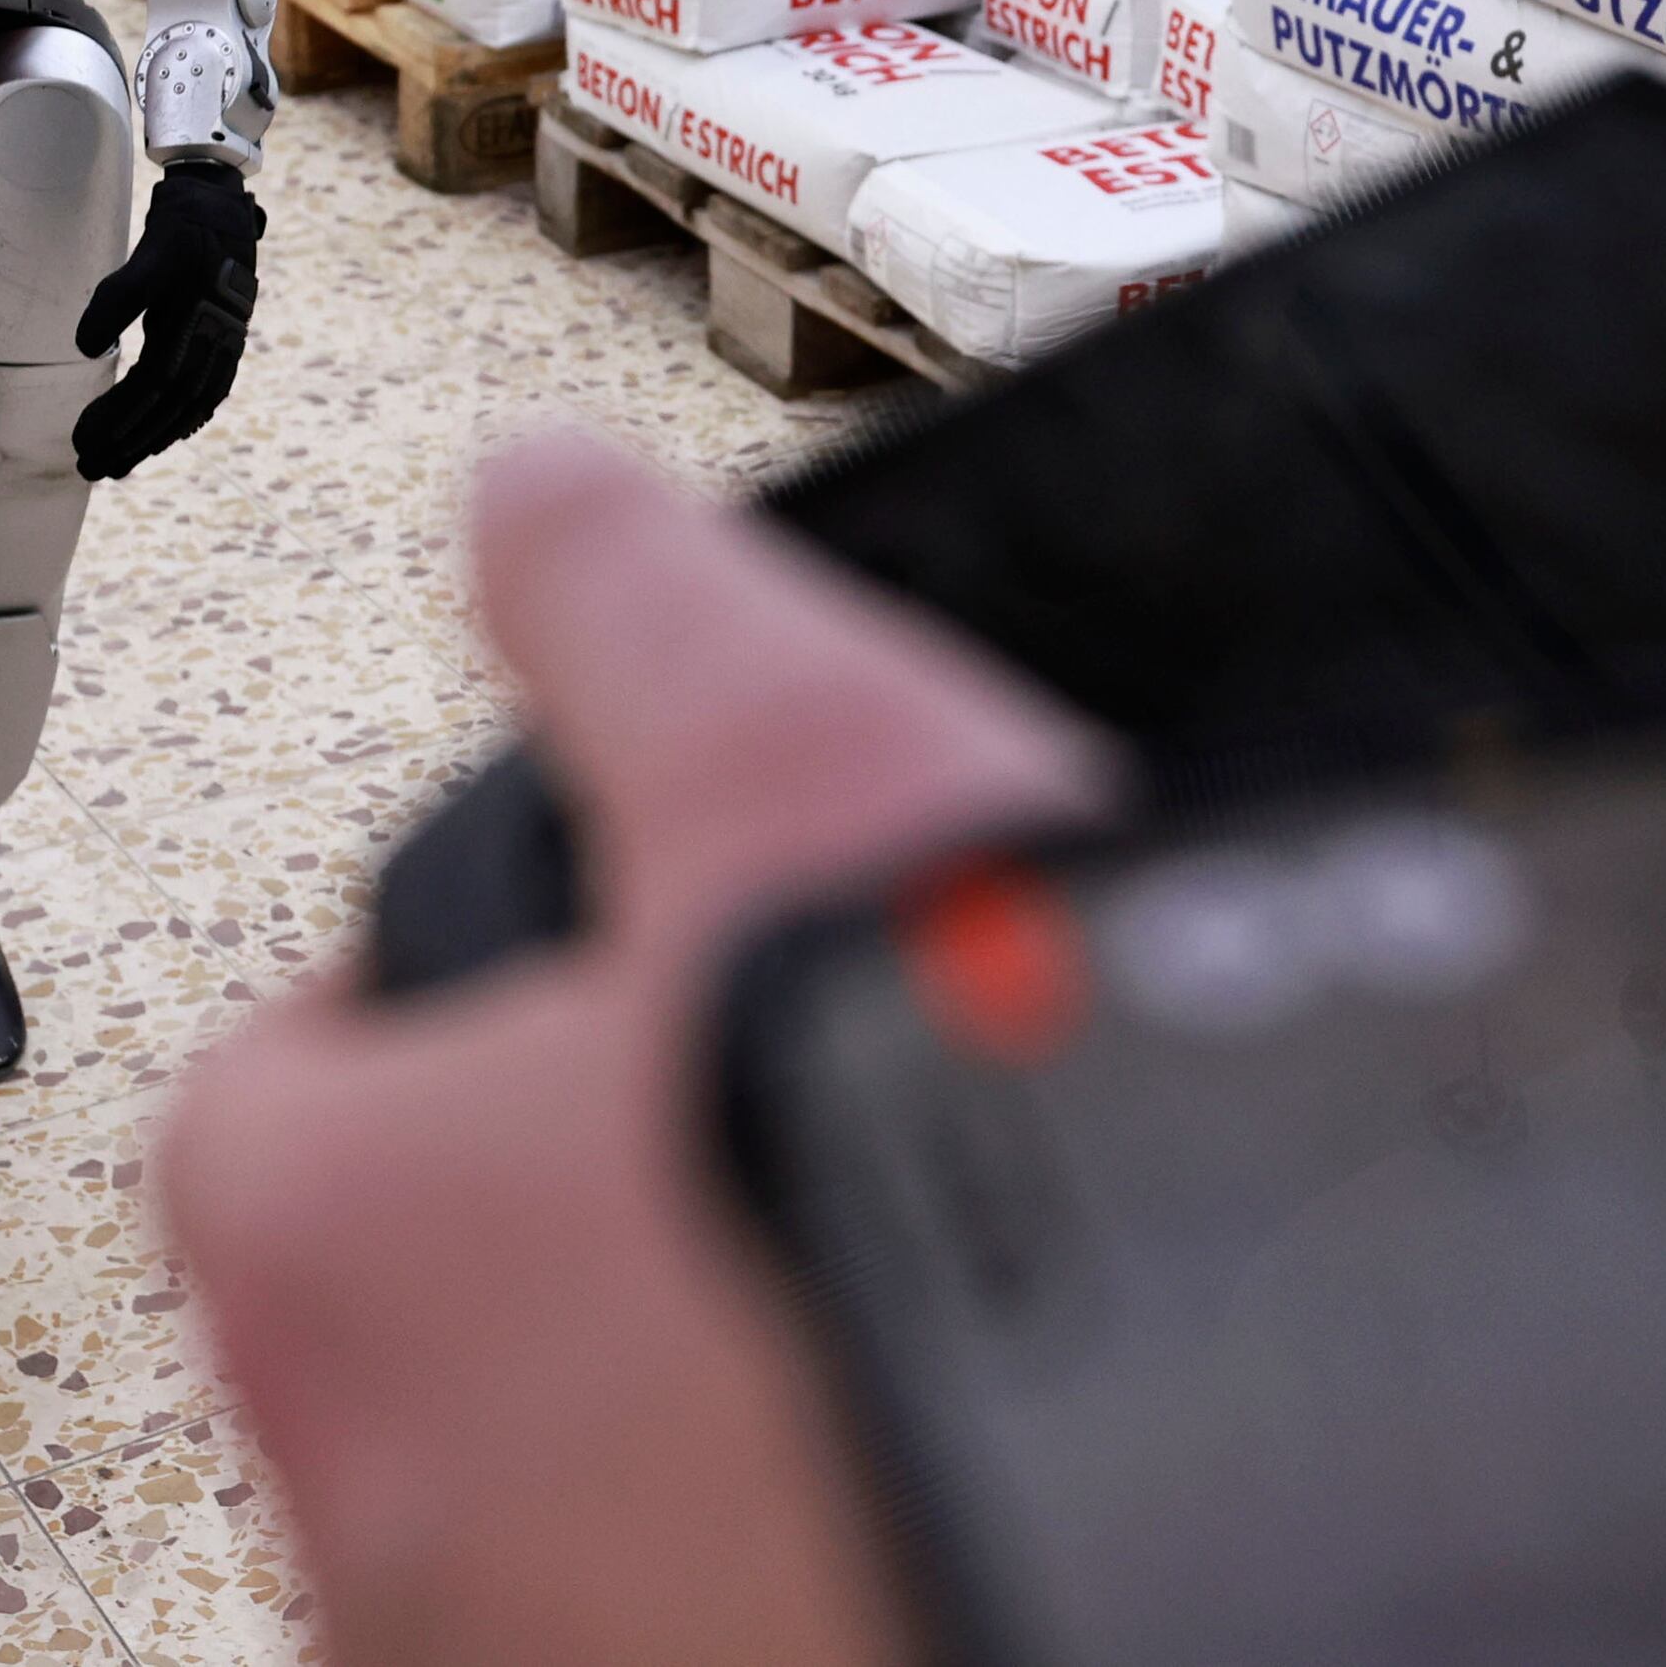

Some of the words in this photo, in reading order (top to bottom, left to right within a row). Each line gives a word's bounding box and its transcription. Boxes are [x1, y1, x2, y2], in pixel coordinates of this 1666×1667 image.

[1489, 28, 1527, 85] &
[576, 50, 662, 131] BETON
[679, 110, 799, 206] ESTRICH
